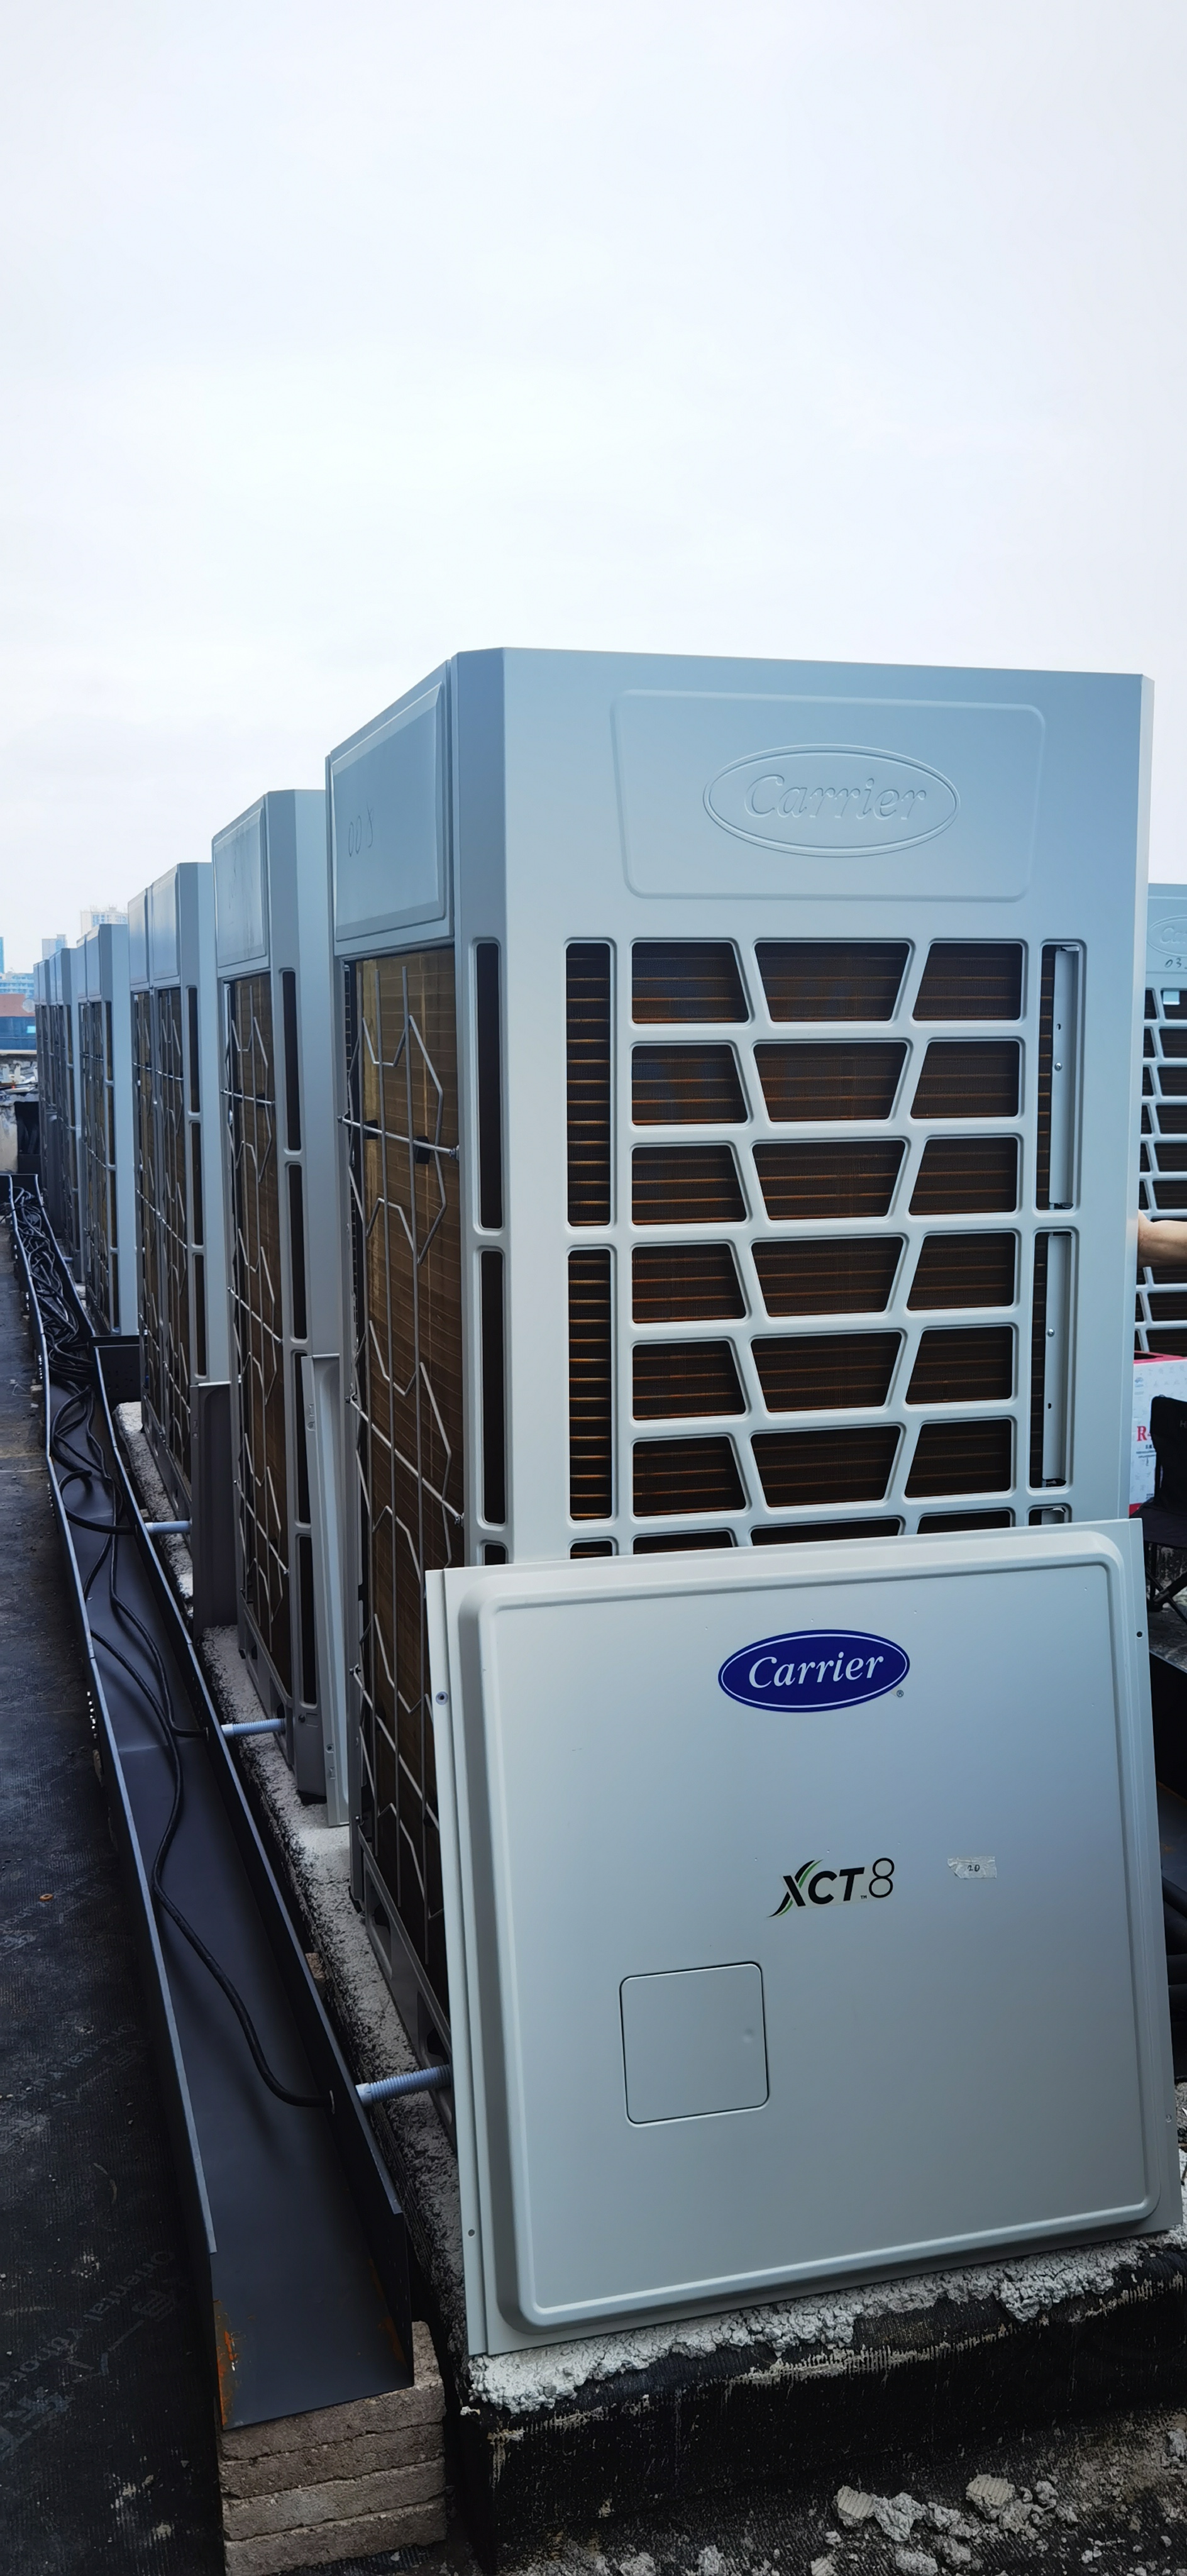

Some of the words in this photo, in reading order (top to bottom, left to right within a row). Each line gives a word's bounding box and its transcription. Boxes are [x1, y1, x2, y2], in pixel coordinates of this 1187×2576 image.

[744, 774, 927, 821] Carrier
[1164, 957, 1187, 970] 03
[748, 1651, 884, 1689] Carrier
